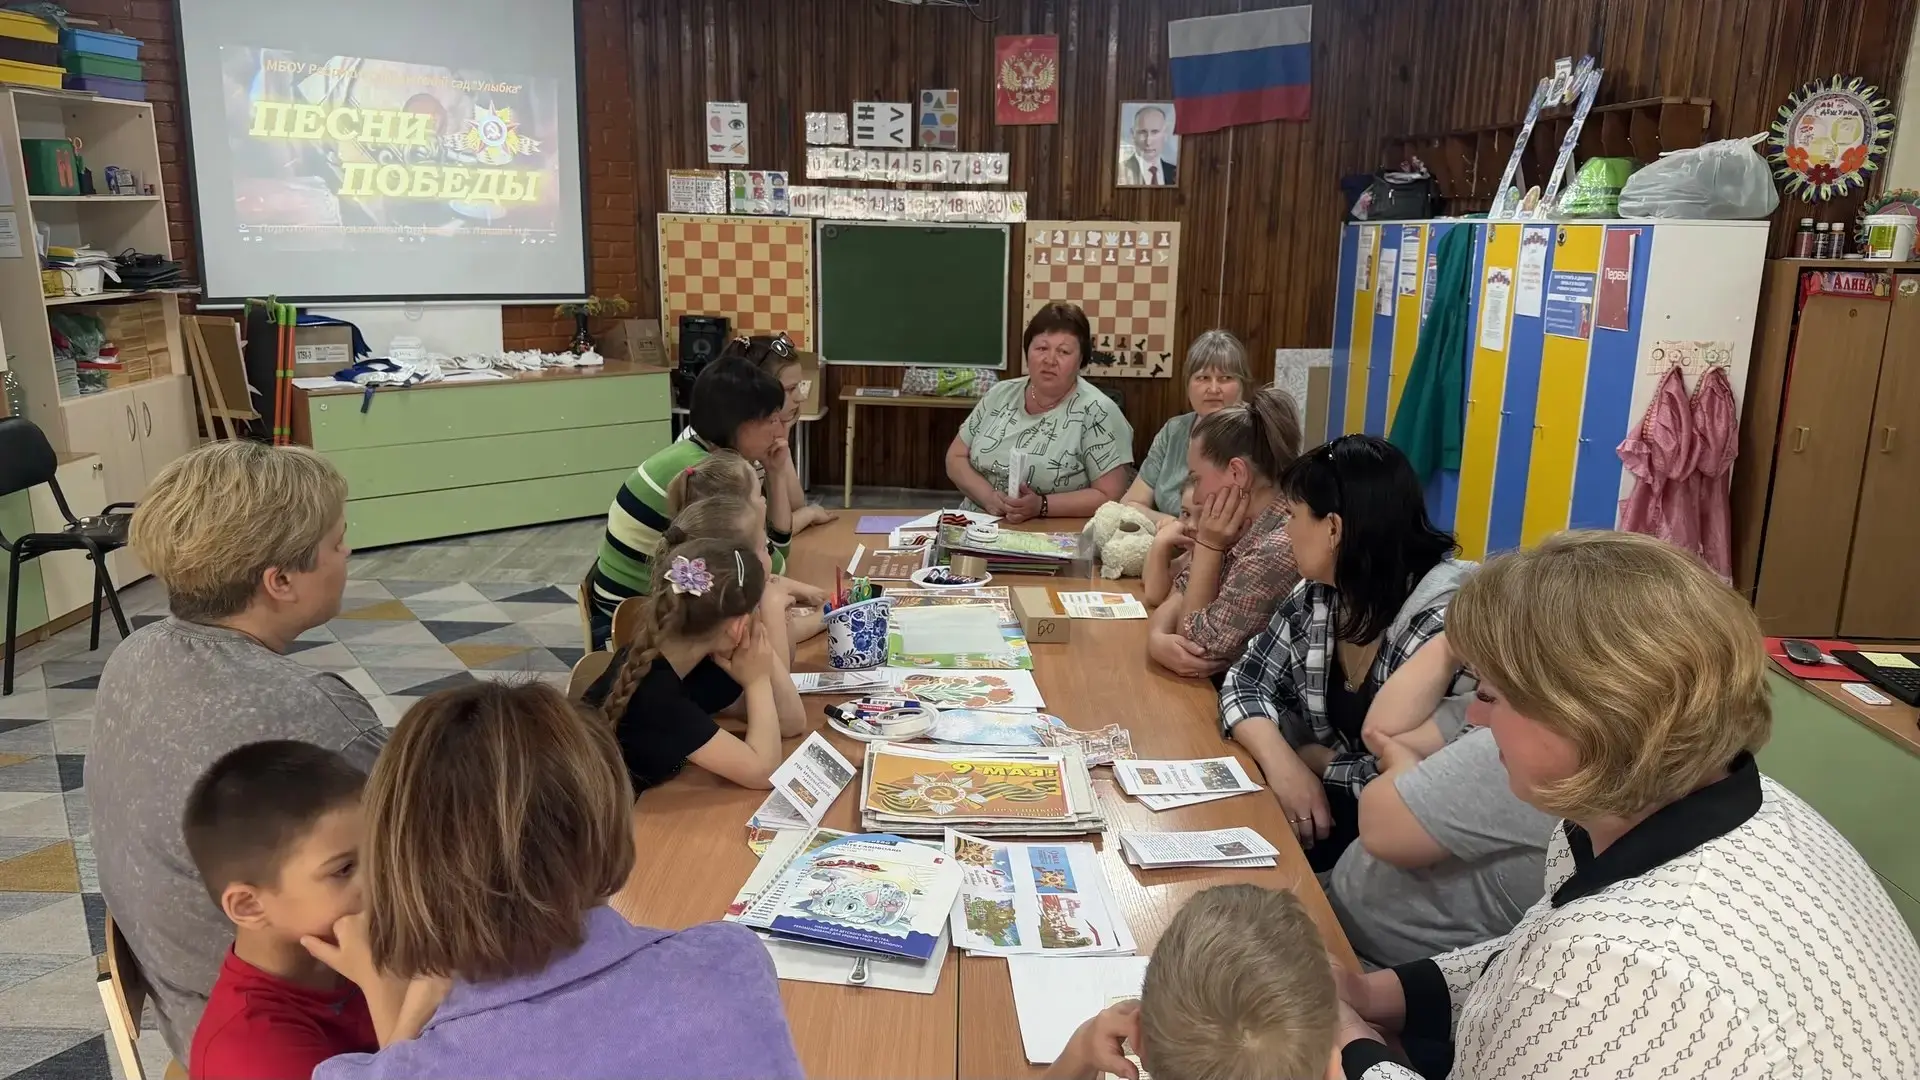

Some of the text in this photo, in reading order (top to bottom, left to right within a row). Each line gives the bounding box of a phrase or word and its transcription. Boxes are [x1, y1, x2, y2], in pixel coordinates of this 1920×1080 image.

[267, 59, 306, 74] МБОУ
[451, 78, 471, 91] сад
[249, 101, 431, 146] ПЕСНИ
[852, 157, 861, 171] 2
[871, 158, 880, 170] 3
[892, 159, 900, 171] 4
[912, 160, 922, 173] 5
[933, 160, 942, 173] 6
[952, 160, 961, 174] 7
[973, 160, 981, 175] 8
[993, 160, 1003, 174] 9
[338, 162, 542, 203] ПОБЕДЫ
[792, 193, 806, 207] 10
[812, 194, 826, 208] 11
[892, 197, 905, 211] 15
[948, 198, 964, 213] 18
[988, 199, 1003, 214] 20
[1605, 267, 1629, 283] Первы
[951, 762, 1058, 777] 9 МАЯ!
[793, 924, 832, 935] РЕКОМЕНДОВАНО
[839, 928, 862, 937] ДЕТСКОГО
